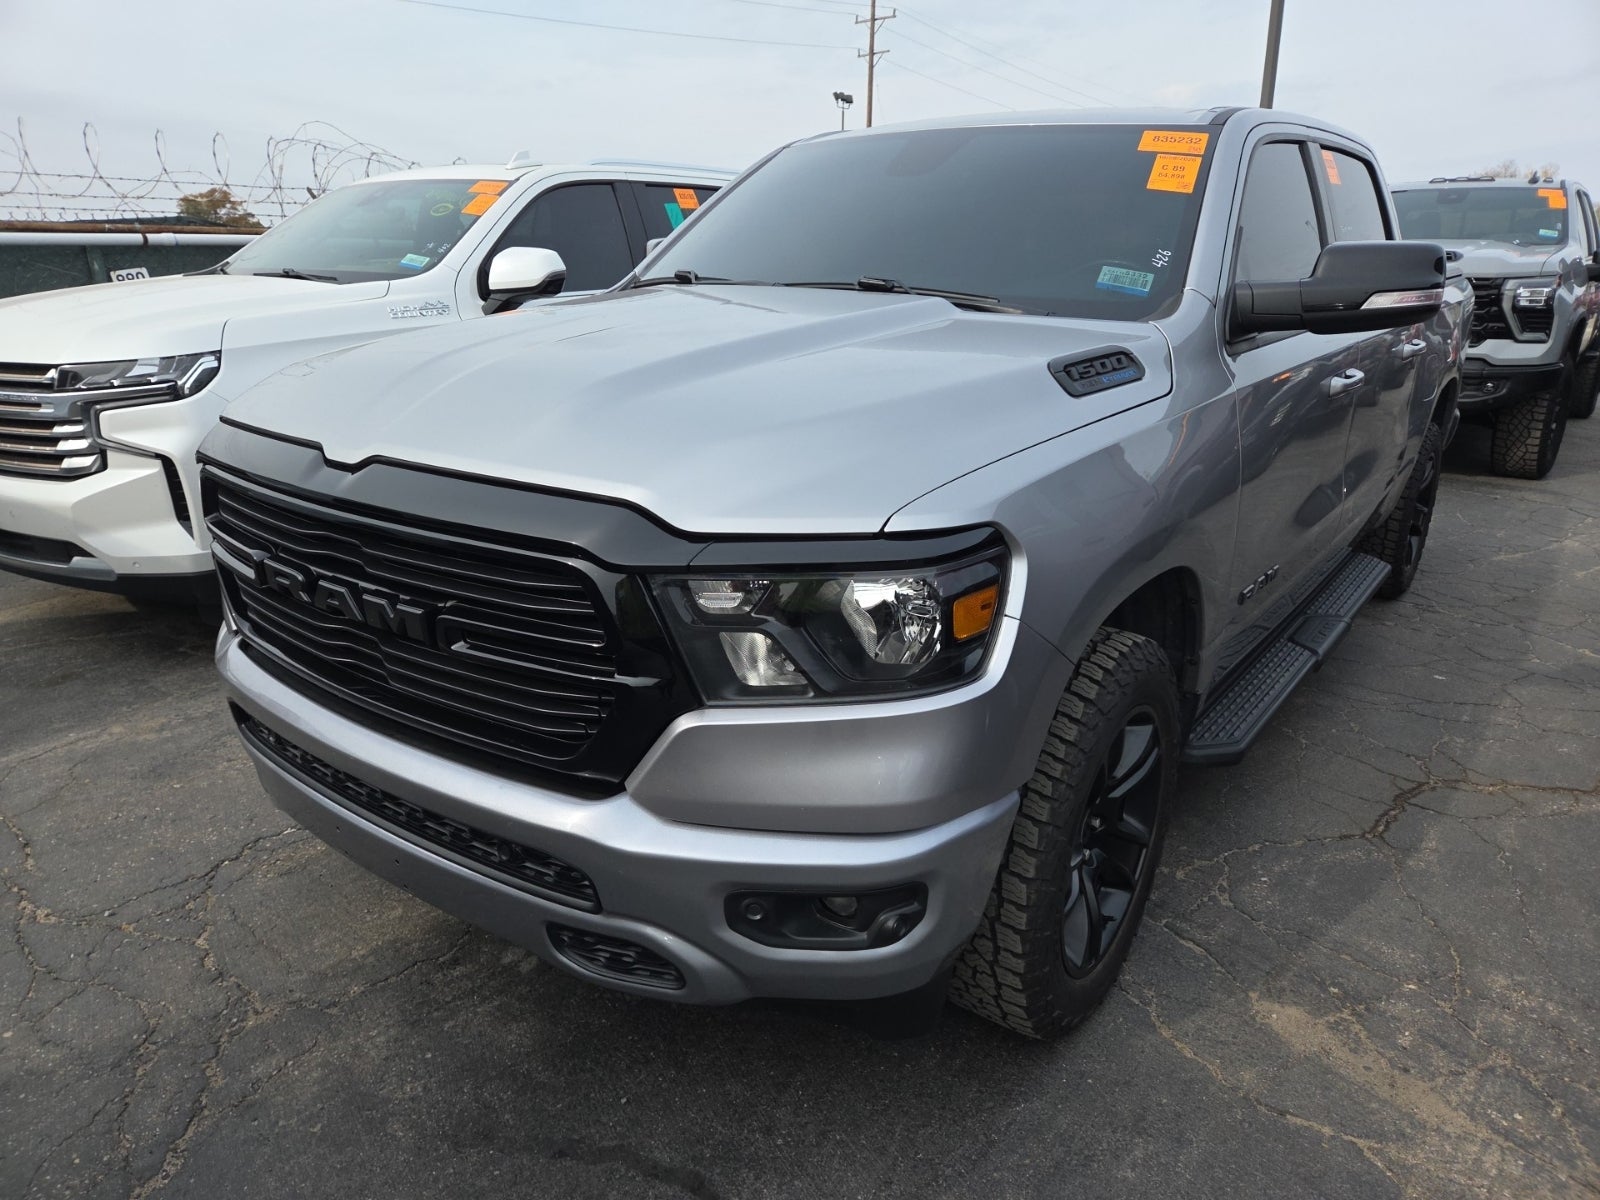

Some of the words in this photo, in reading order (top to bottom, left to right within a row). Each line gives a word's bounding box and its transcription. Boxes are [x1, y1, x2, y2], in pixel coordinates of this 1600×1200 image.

[1152, 135, 1202, 145] 835232
[1151, 248, 1172, 268] 426
[1065, 354, 1130, 381] 1500
[258, 556, 427, 643] RAM
